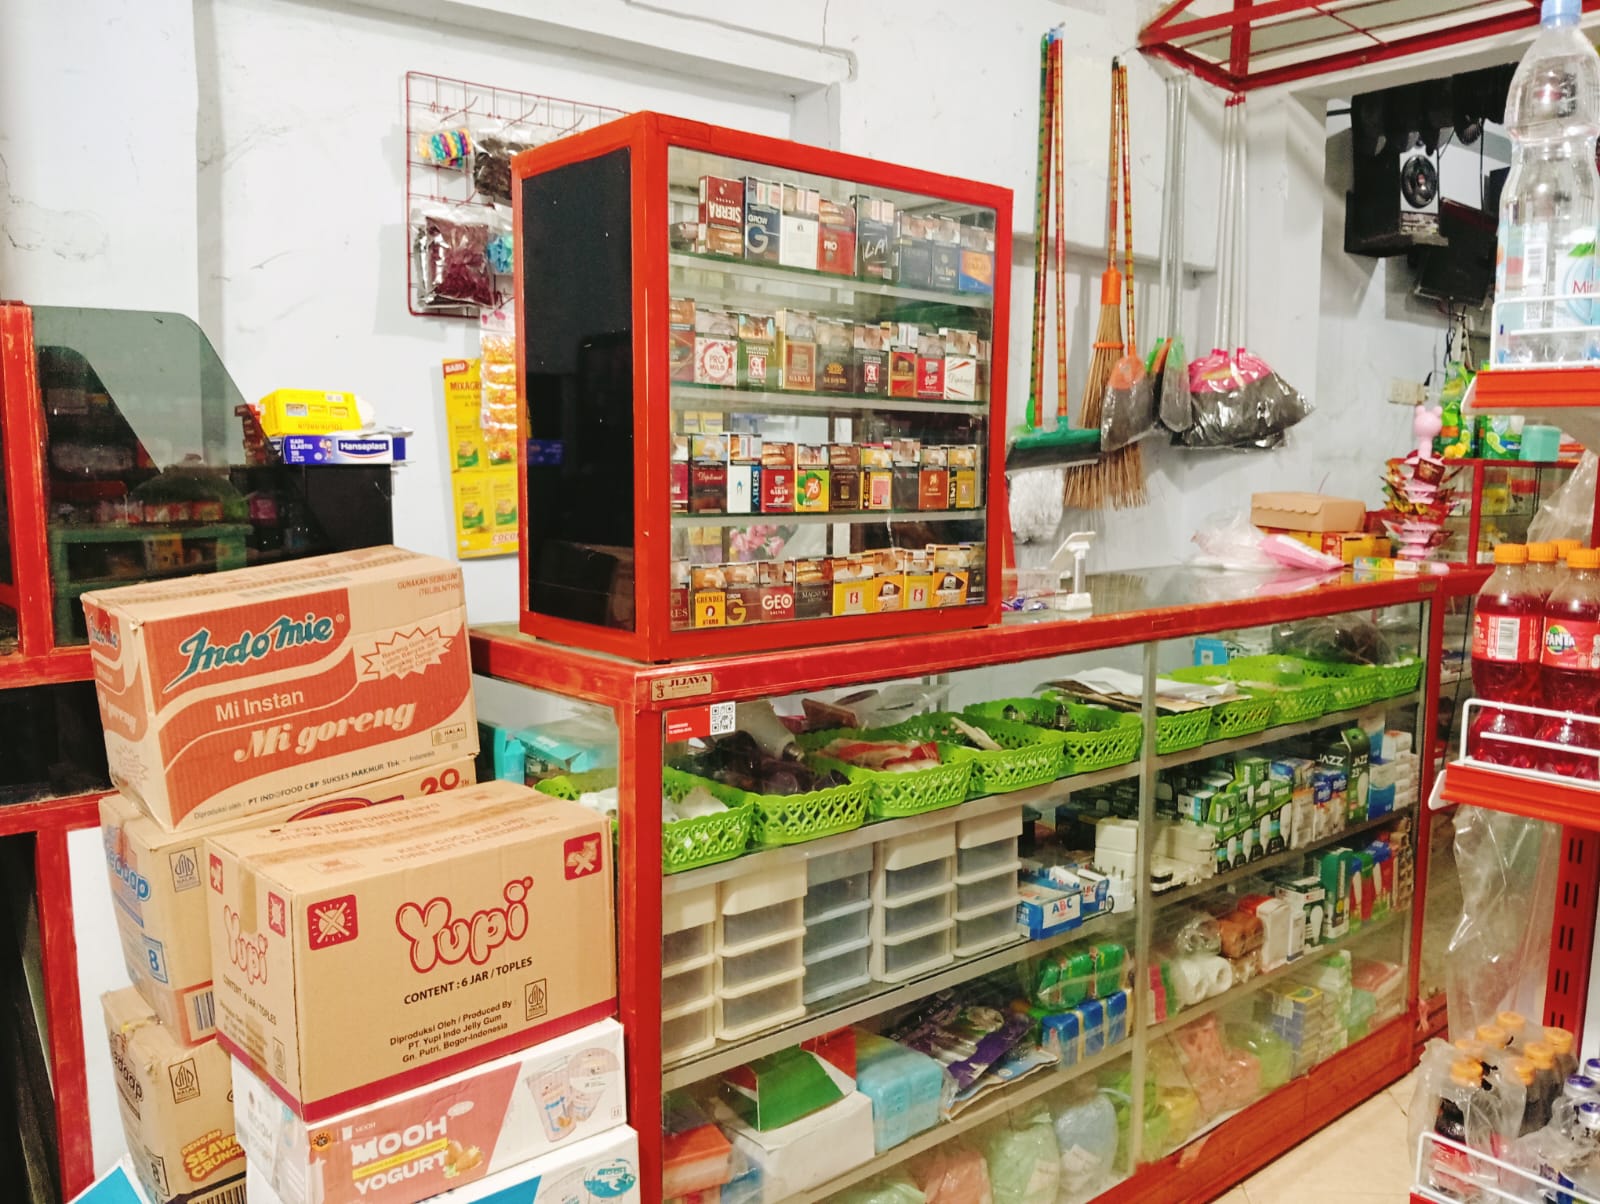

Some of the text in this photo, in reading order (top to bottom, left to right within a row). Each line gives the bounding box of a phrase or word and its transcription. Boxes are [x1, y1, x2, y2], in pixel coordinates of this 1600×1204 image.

[708, 201, 742, 223] SIERRA
[340, 442, 387, 452] Hansaplast
[807, 480, 819, 497] 76
[761, 593, 793, 611] GEO
[1546, 632, 1576, 651] FANTA
[215, 690, 305, 723] Mi Instan
[233, 701, 417, 763] Mi goreng
[1316, 753, 1346, 767] JAZZ
[1352, 753, 1369, 768] JAZZ
[248, 794, 258, 806] PT
[321, 773, 350, 786] SUKSES
[350, 763, 384, 779] MAKMUR
[386, 758, 401, 769] Tbk
[420, 768, 460, 794] 20
[1052, 898, 1073, 914] ABC
[395, 876, 534, 974] Yupi
[224, 904, 268, 985] Yupi
[148, 948, 160, 972] 8
[404, 981, 455, 1005] CONTENT
[461, 977, 469, 988] 6
[470, 970, 489, 985] JAR
[496, 957, 533, 977] TOPLES
[389, 1023, 436, 1046] Diproduksi
[437, 1018, 457, 1031] Oleh
[463, 1003, 501, 1022] Produced
[502, 1000, 513, 1009] By
[423, 1034, 442, 1046] Yupi
[443, 1027, 461, 1039] Indo
[462, 1021, 482, 1033] Jelly
[483, 1014, 502, 1025] Gum
[443, 1022, 509, 1050] Bogor-Indonesia
[182, 1130, 221, 1155] DENGAN
[351, 1115, 447, 1166] MOOH
[354, 1149, 448, 1195] YOGURT
